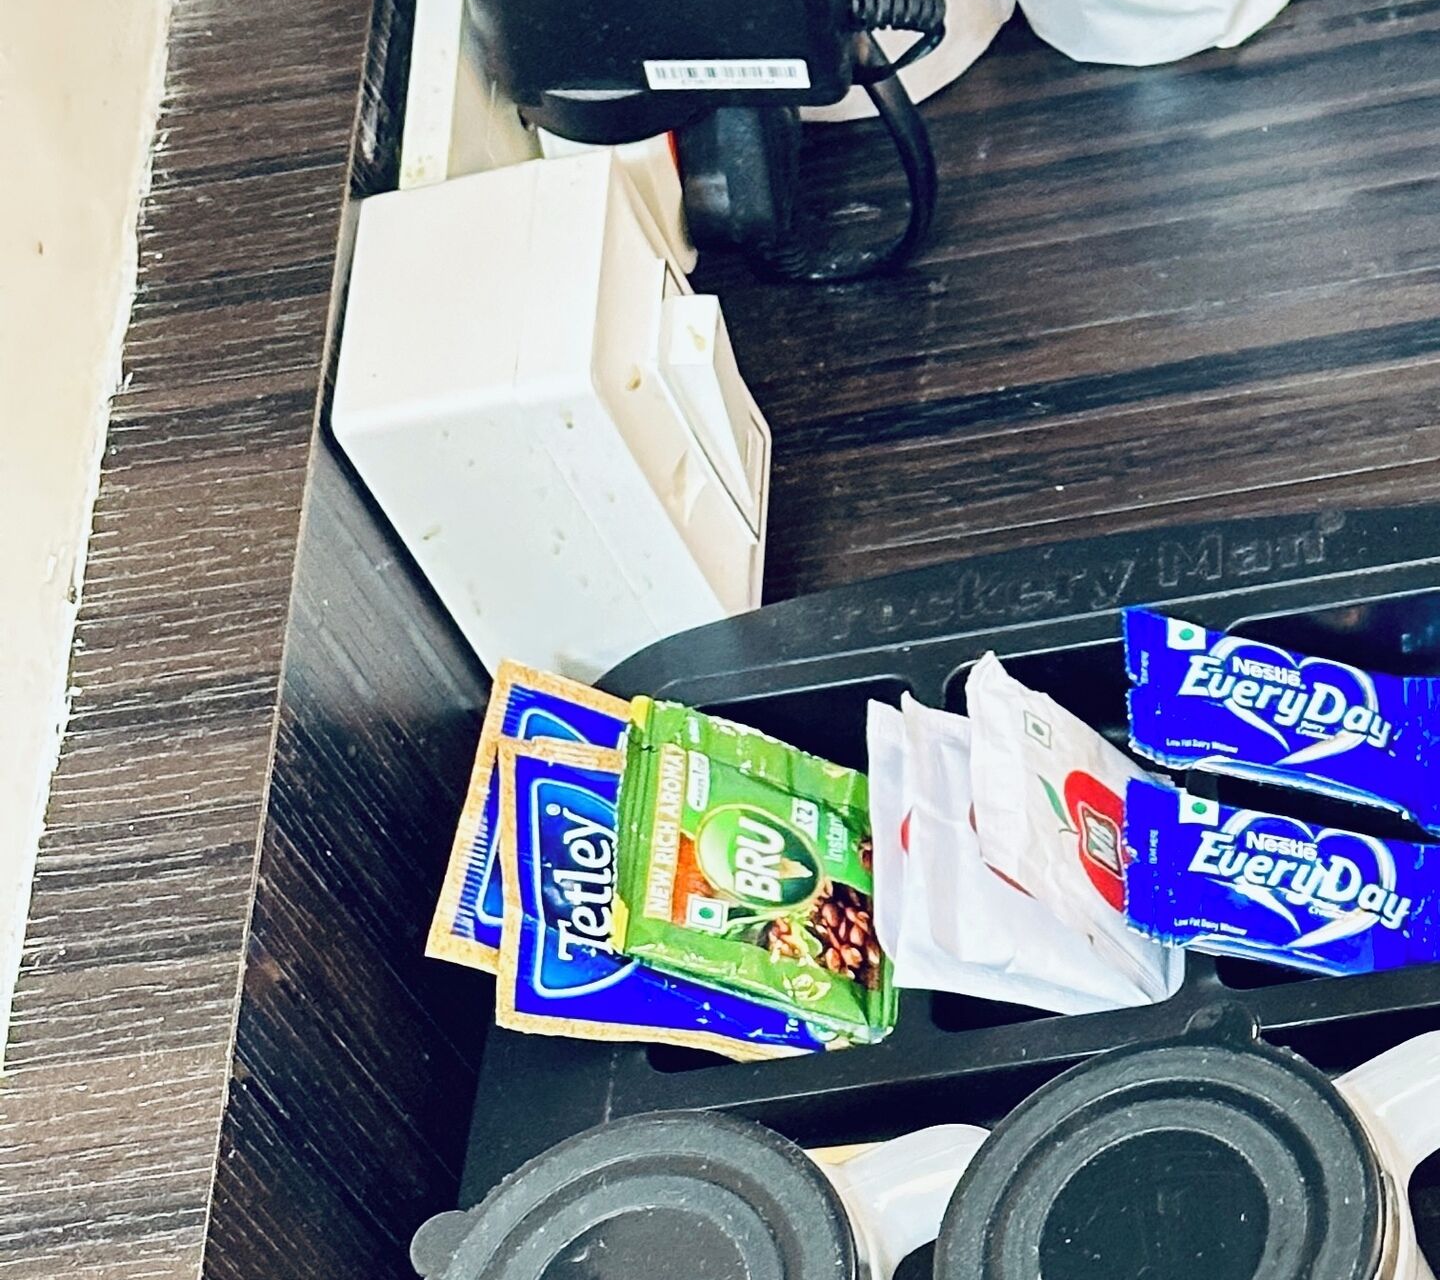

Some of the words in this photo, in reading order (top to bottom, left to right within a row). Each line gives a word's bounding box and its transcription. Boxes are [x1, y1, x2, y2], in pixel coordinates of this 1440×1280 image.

[654, 823, 680, 862] RICH
[734, 815, 787, 903] BRU
[553, 808, 617, 961] Tetley
[646, 865, 671, 917] NEW
